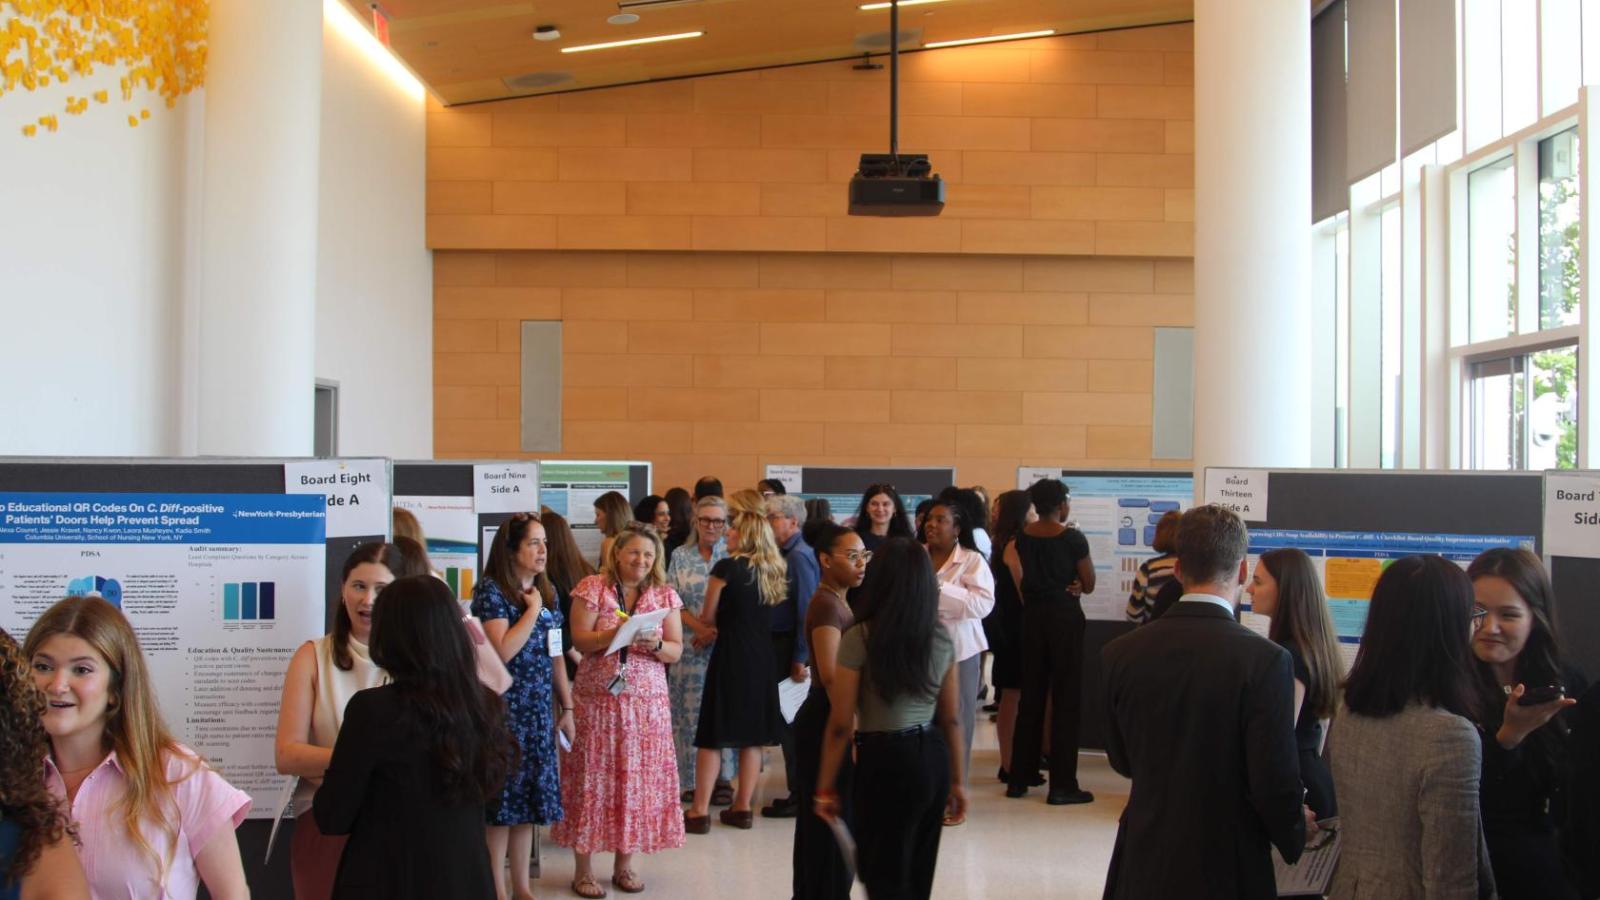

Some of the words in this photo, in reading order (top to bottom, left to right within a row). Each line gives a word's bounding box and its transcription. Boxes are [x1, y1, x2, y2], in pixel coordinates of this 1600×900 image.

[300, 474, 336, 484] Board
[340, 472, 371, 486] Eight
[1226, 477, 1248, 486] Board
[490, 485, 510, 494] Side
[512, 484, 520, 493] A
[1220, 489, 1253, 498] Thirteen
[327, 494, 344, 506] de
[349, 494, 360, 506] A
[1556, 490, 1594, 502] Board
[8, 502, 72, 512] Educational
[73, 502, 90, 513] QR
[92, 502, 127, 512] Codes
[128, 503, 144, 513] On
[146, 503, 158, 513] C.
[160, 503, 224, 514] Diff-positive
[1242, 504, 1250, 512] A
[6, 514, 54, 524] Patients'
[56, 514, 88, 524] Doors
[90, 515, 115, 526] Help
[117, 515, 159, 525] Prevent
[160, 516, 200, 526] Spread
[238, 510, 325, 519] NewYork-Presbyterian
